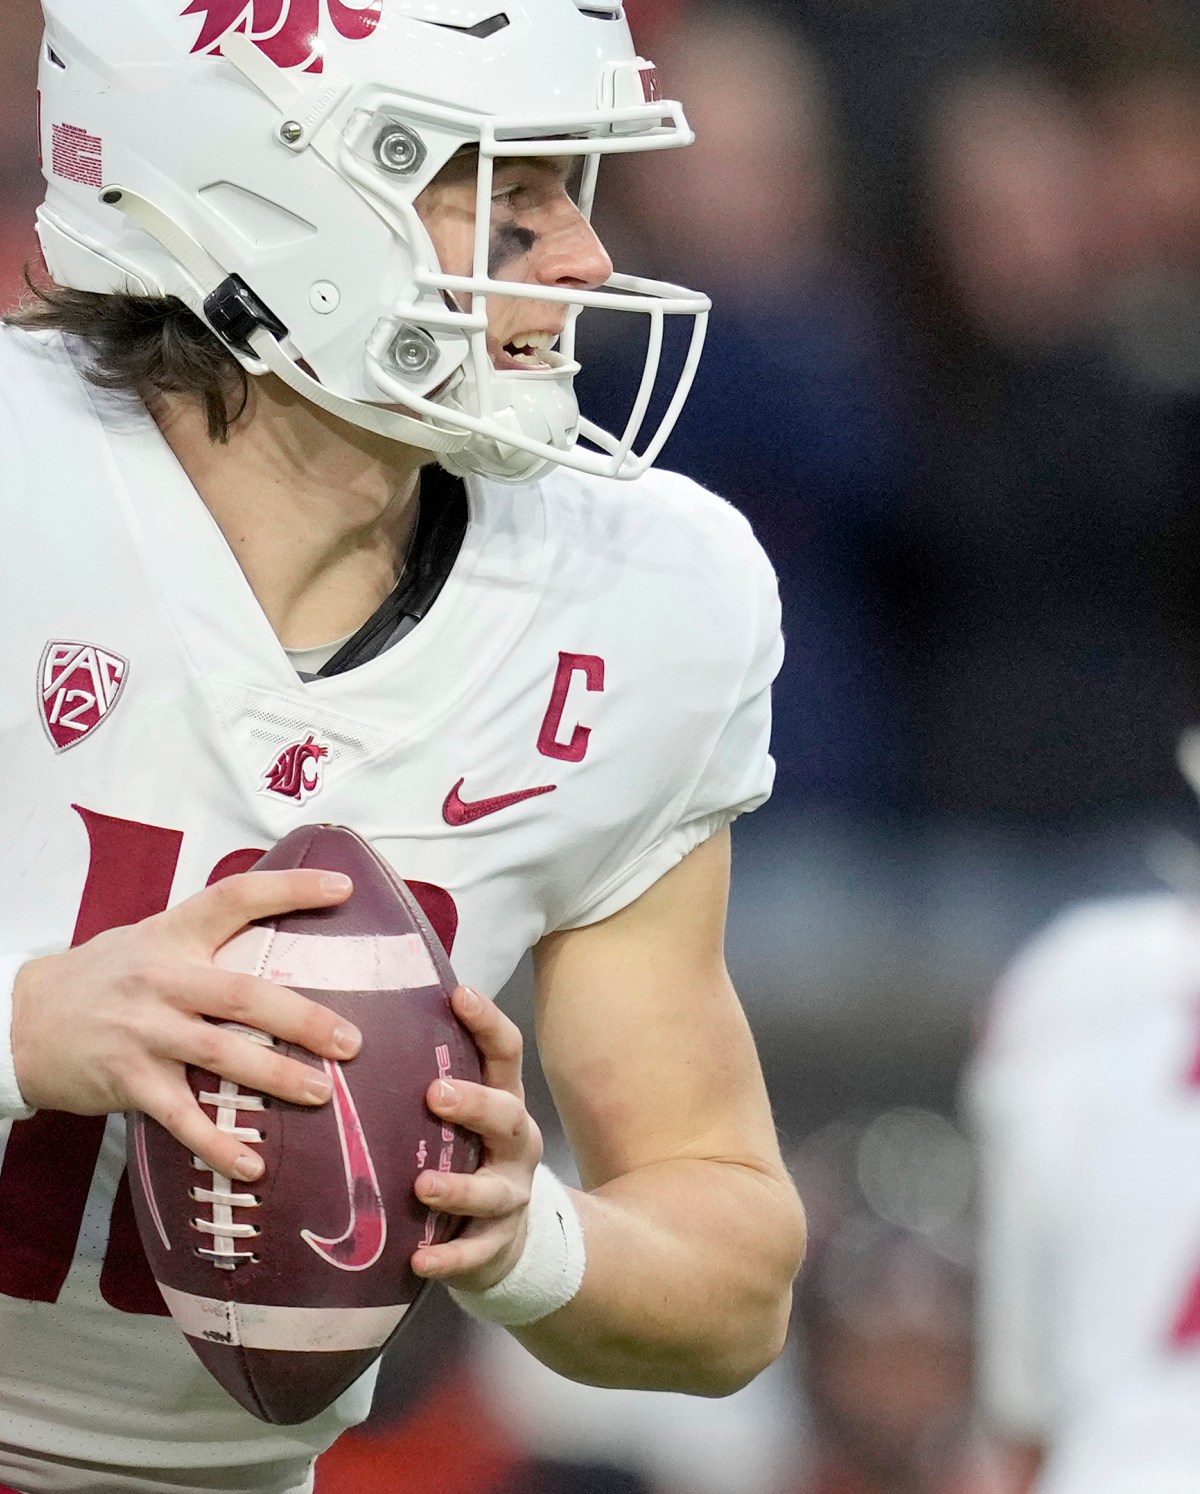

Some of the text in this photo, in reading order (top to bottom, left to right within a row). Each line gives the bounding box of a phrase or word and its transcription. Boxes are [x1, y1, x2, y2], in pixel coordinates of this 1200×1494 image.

[43, 644, 125, 718] PAC
[48, 687, 97, 732] 12
[536, 650, 605, 763] C
